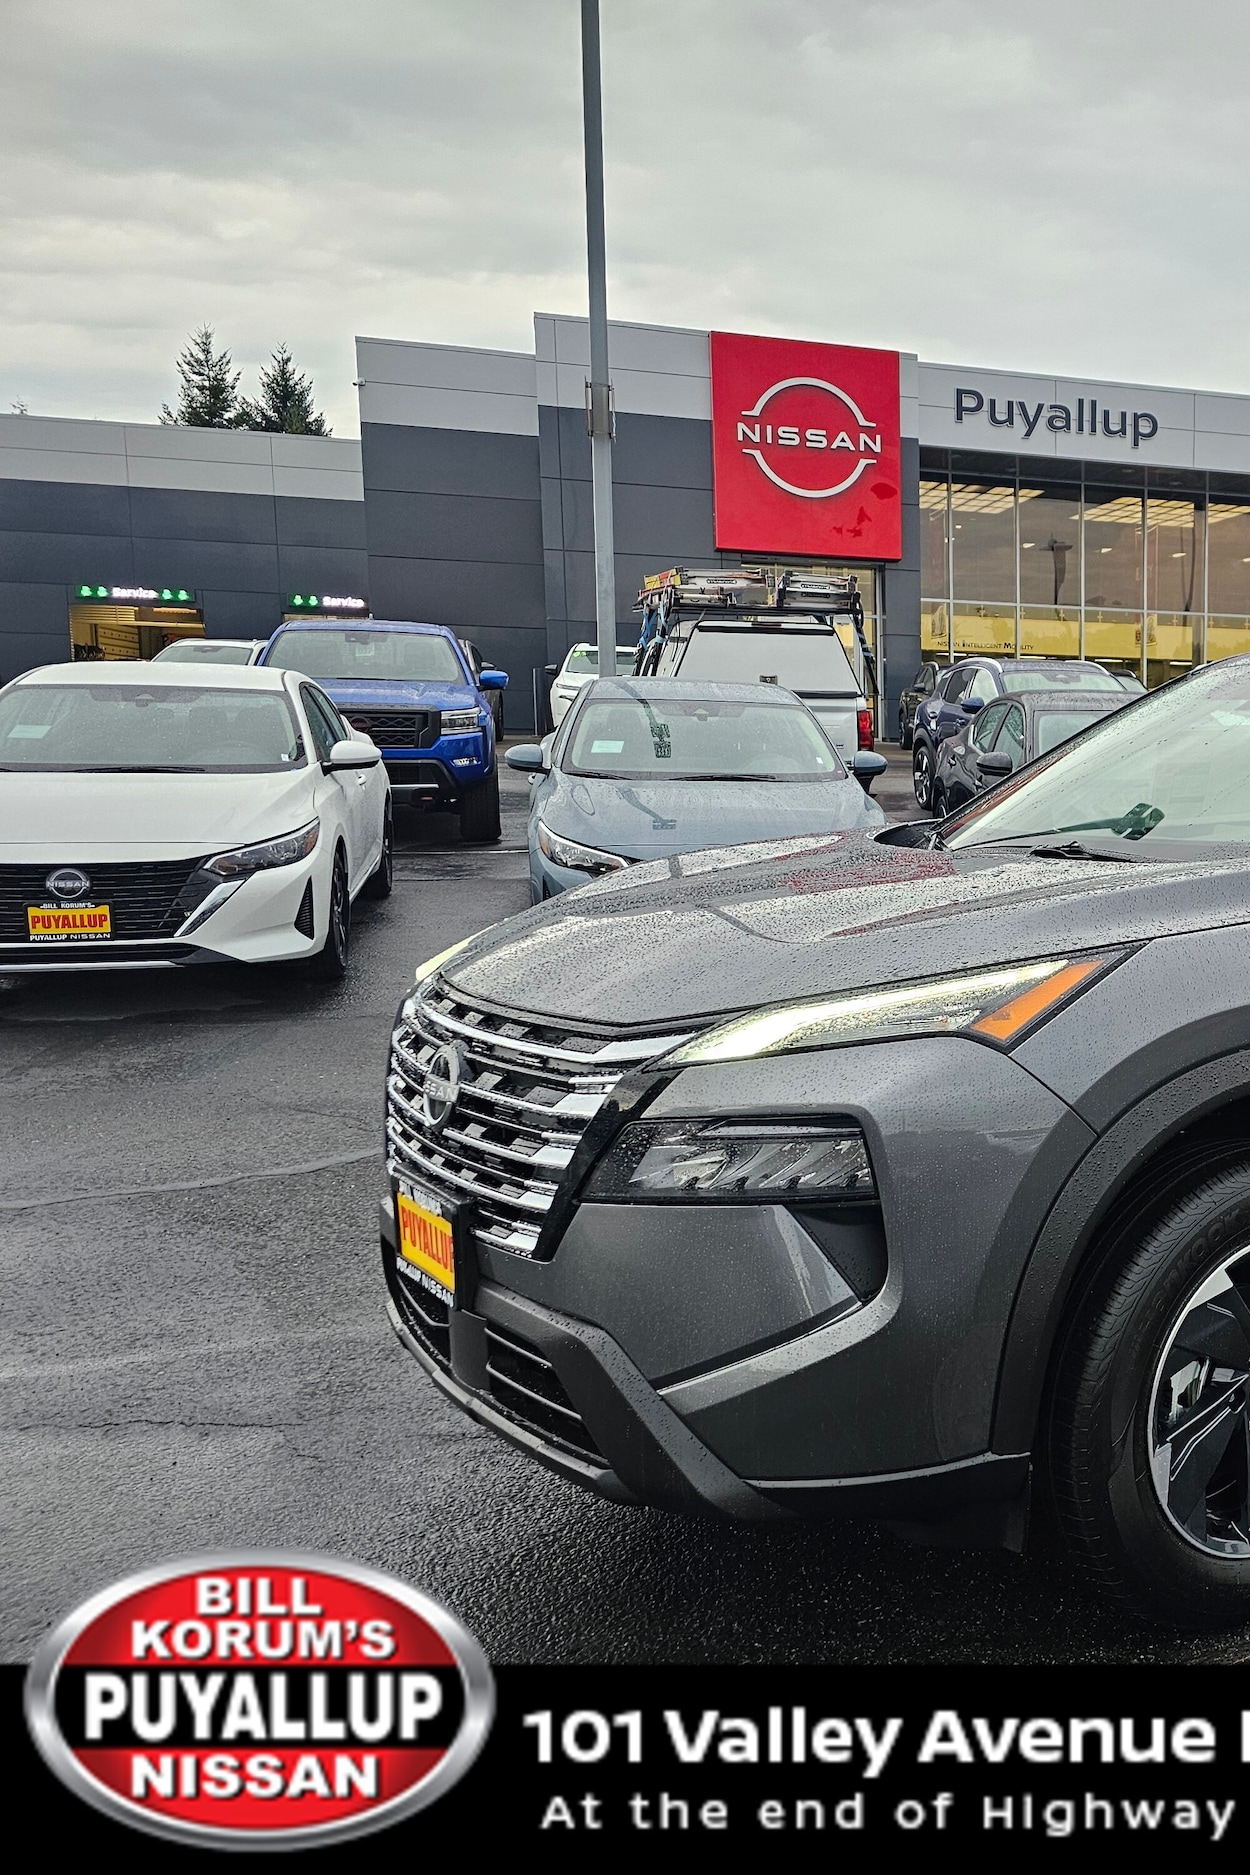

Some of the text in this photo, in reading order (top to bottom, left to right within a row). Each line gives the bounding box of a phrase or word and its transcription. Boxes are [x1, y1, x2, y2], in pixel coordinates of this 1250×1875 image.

[955, 387, 1159, 449] Puyallup
[737, 422, 882, 453] NISSAN
[112, 586, 160, 599] Service
[30, 913, 108, 930] PUYALLUP
[29, 932, 111, 942] PUYALLUP NISSAN
[421, 1273, 454, 1308] NISSAN
